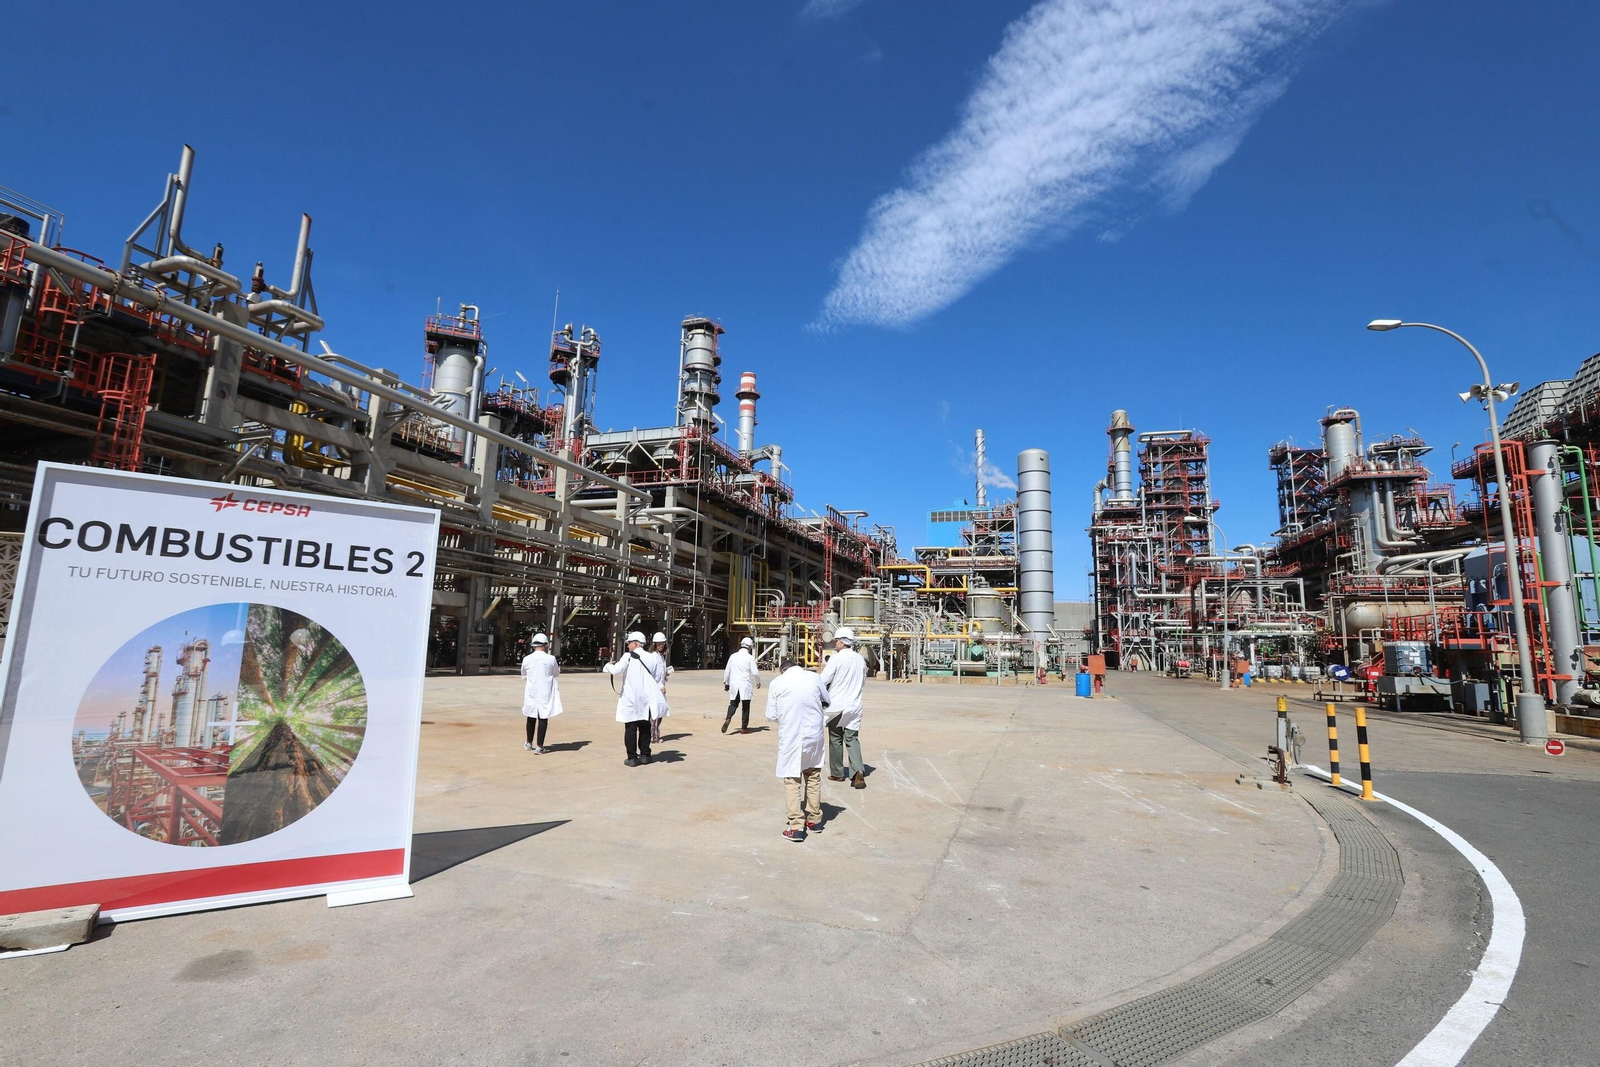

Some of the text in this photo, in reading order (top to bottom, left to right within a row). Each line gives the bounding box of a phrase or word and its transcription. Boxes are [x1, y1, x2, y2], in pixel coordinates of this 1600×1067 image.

[242, 498, 312, 518] CEPSA
[38, 516, 426, 578] COMBUSTIBLES 2
[68, 565, 398, 598] TU FUTURO SOSTENIBLE, NUESTRA HISTORIA.
